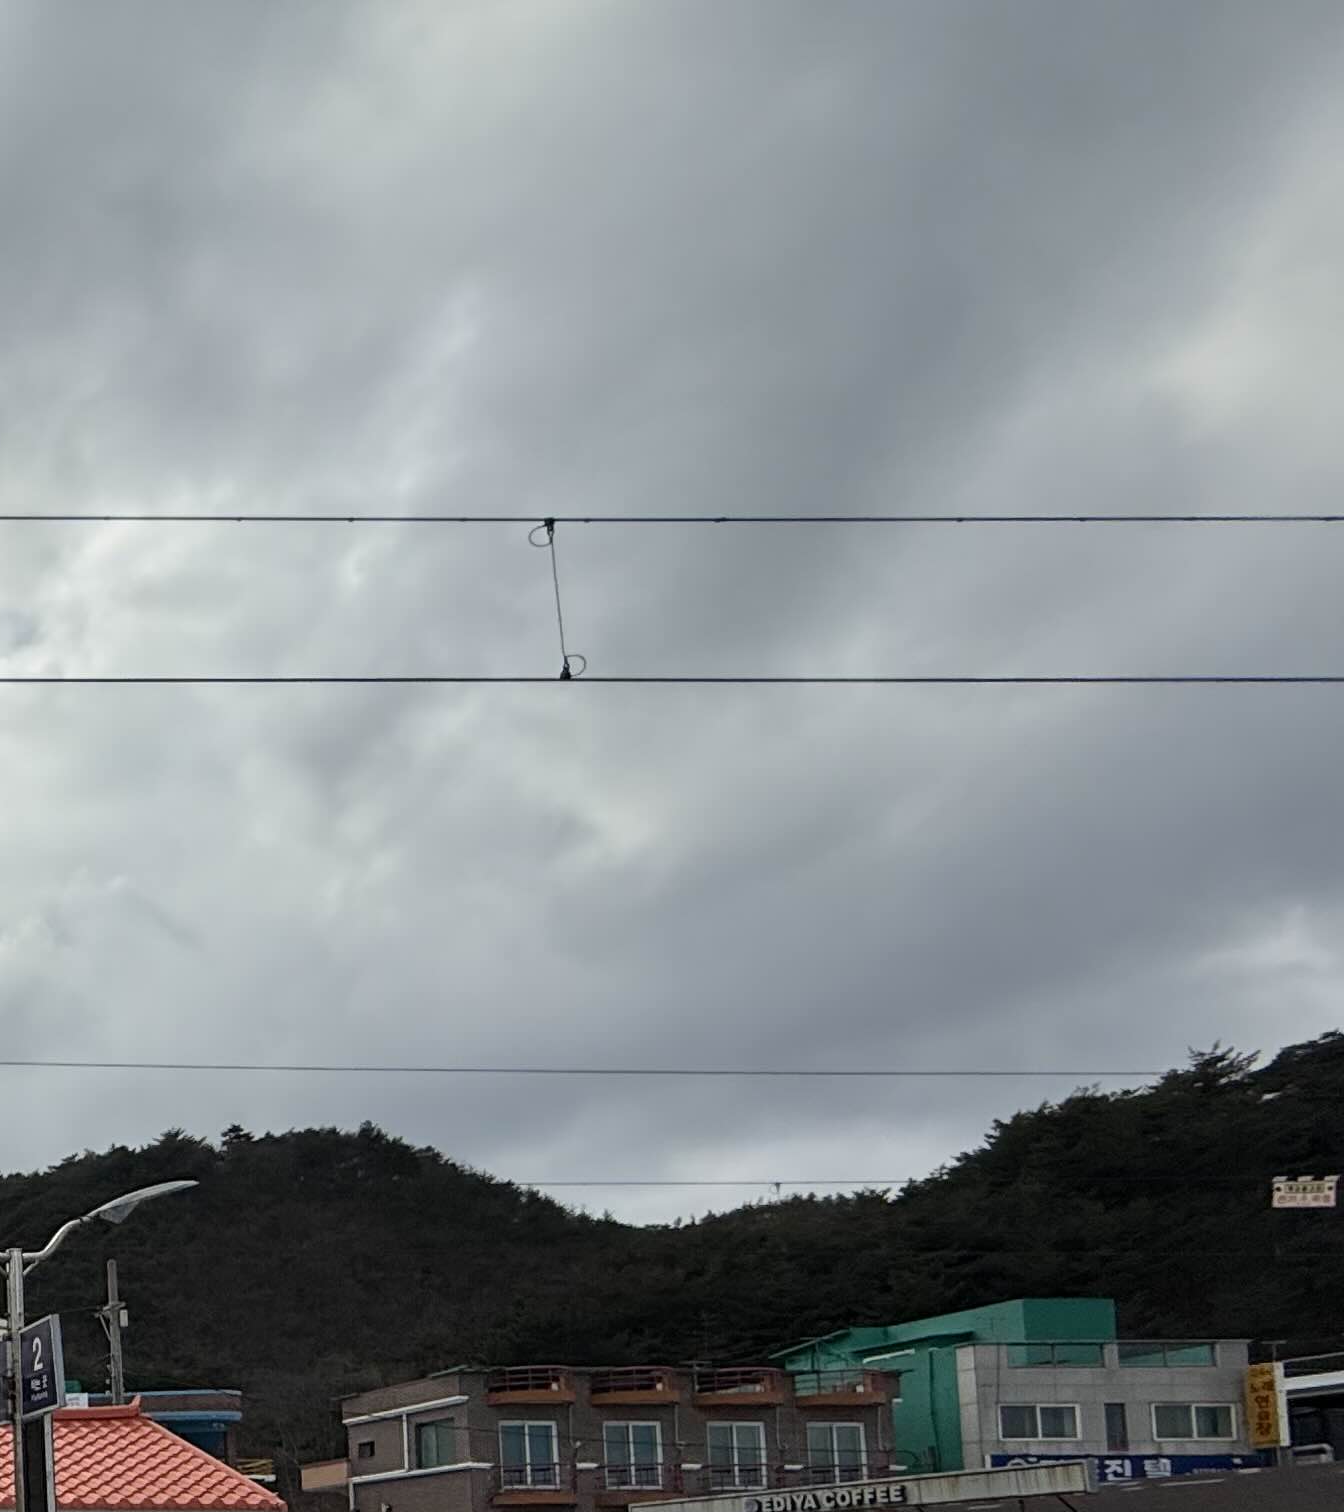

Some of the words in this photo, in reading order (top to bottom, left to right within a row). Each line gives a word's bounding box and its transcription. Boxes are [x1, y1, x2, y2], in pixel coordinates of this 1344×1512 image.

[32, 1336, 44, 1371] 2
[761, 1493, 819, 1512] EDIYA
[821, 1485, 905, 1509] COFFEE
